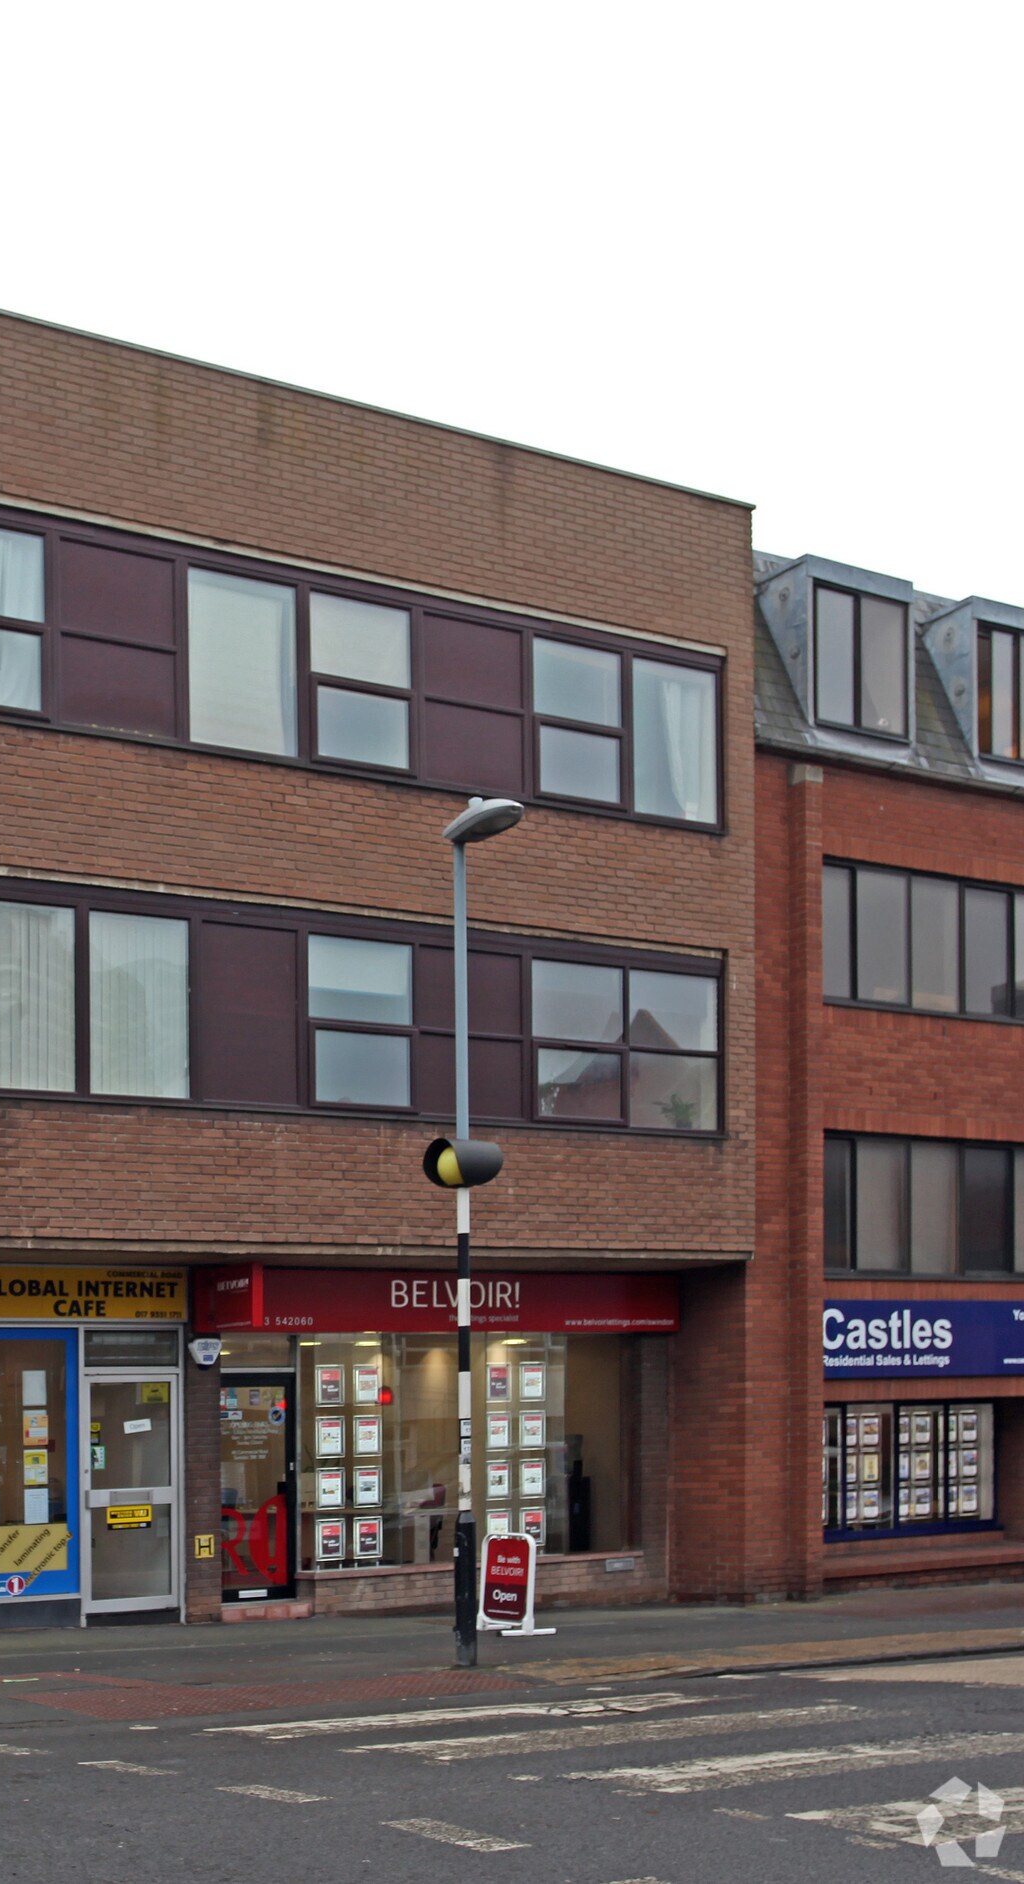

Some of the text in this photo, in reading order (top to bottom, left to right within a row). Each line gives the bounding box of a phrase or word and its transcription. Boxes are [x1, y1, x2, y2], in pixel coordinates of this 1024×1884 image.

[107, 1270, 183, 1279] COMMERCIAL ROAD
[78, 1281, 178, 1298] INTERNET
[391, 1280, 520, 1308] BELVOIR!
[53, 1299, 106, 1317] CAFE
[276, 1317, 314, 1326] 542060
[488, 1314, 519, 1323] specialist
[822, 1308, 953, 1350] Castles
[876, 1354, 902, 1366] Sales
[904, 1354, 911, 1365] &
[913, 1354, 950, 1368] Lettings
[13, 1528, 51, 1567] laminating
[198, 1538, 212, 1555] H
[507, 1556, 521, 1564] with
[492, 1589, 518, 1604] Open
